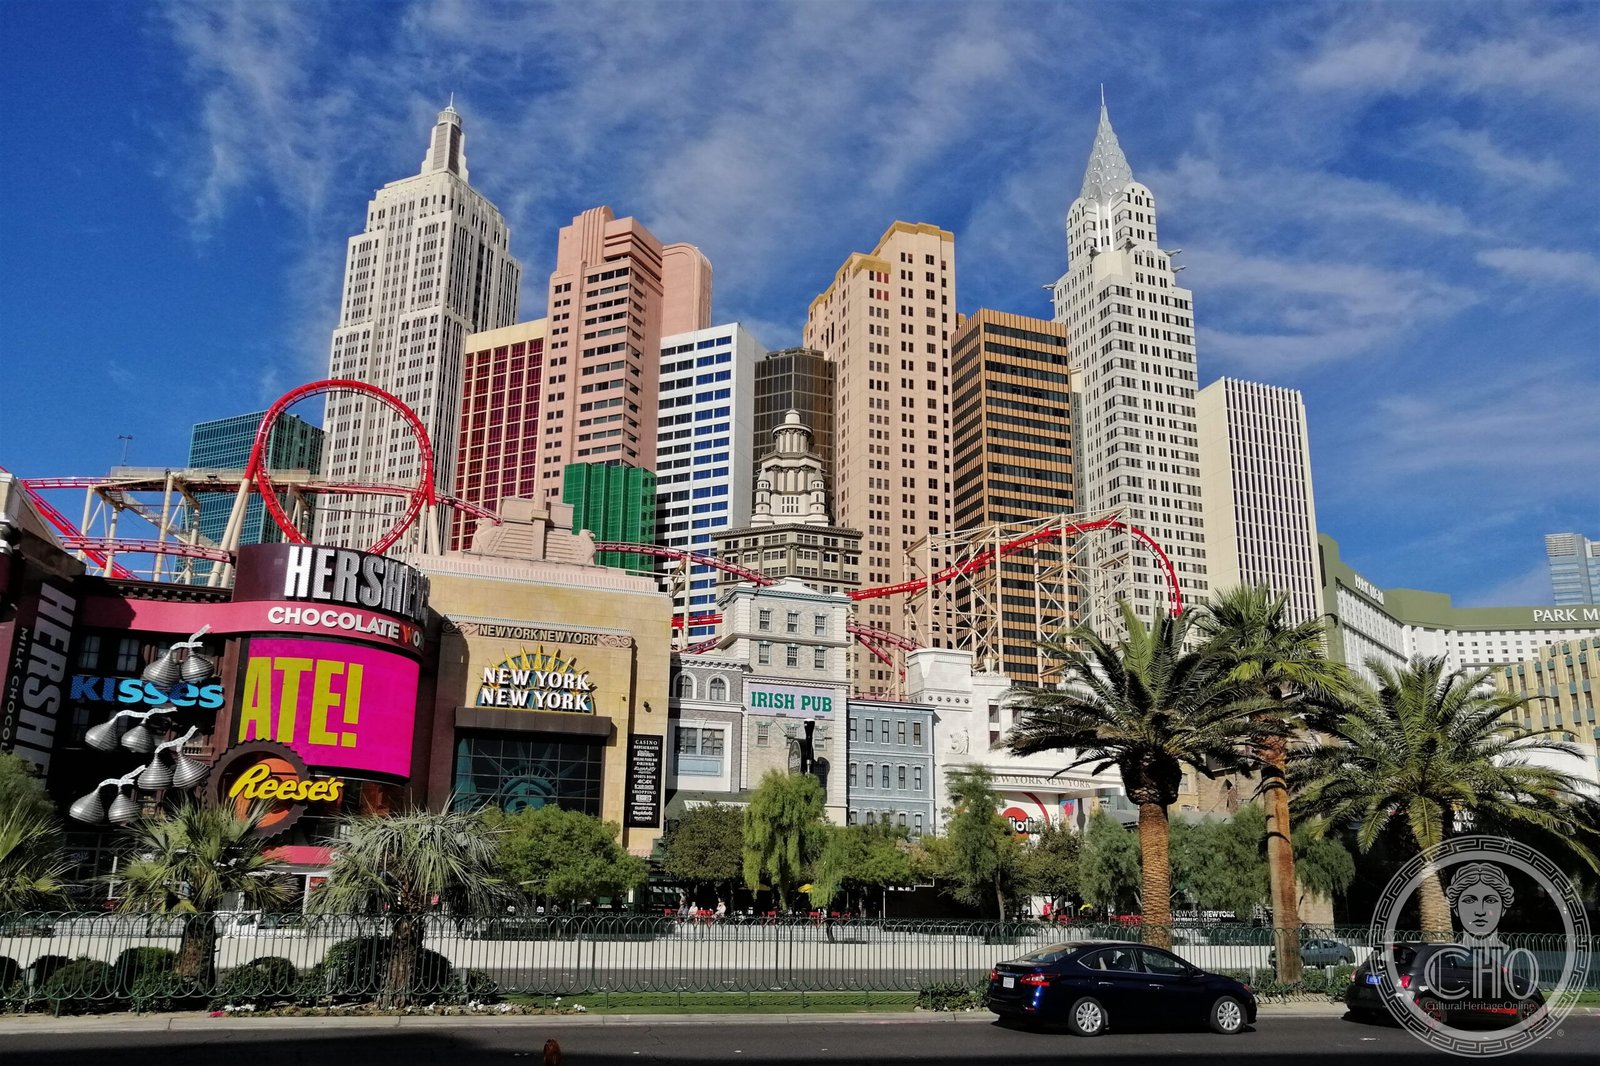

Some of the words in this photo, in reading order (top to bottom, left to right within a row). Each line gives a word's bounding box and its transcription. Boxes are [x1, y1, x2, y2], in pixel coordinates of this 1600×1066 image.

[268, 606, 400, 639] CHOCOLATE
[1533, 608, 1578, 621] PARK
[1583, 608, 1600, 621] M
[14, 627, 29, 669] MILK
[483, 666, 530, 686] NEW
[535, 671, 590, 690] YORK
[239, 656, 364, 748] ATE!
[481, 687, 529, 706] NEW
[534, 691, 590, 711] YORK
[751, 691, 795, 710] IRISH
[801, 695, 832, 712] PUB
[229, 763, 343, 801] Reese's
[1012, 776, 1043, 785] YORK
[1043, 778, 1067, 787] NEW
[1068, 780, 1092, 789] YORK
